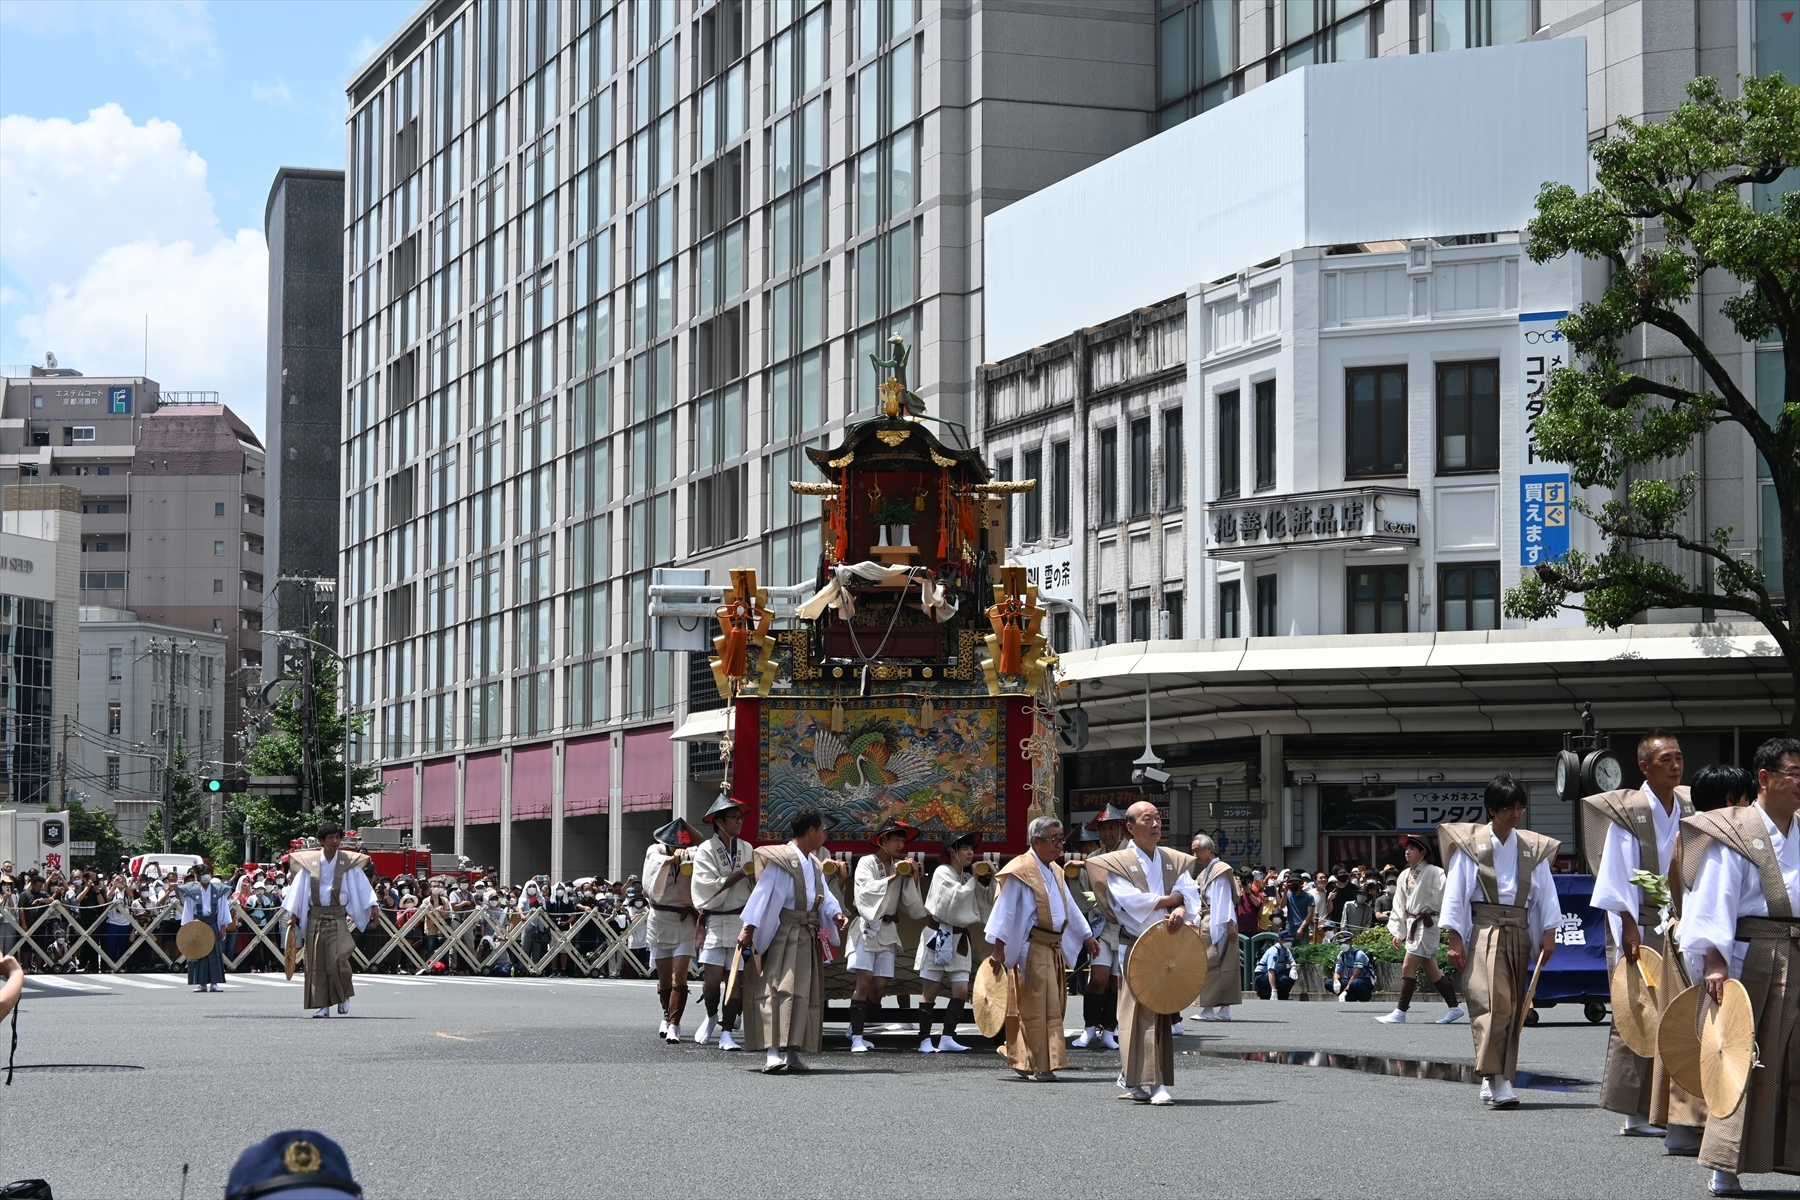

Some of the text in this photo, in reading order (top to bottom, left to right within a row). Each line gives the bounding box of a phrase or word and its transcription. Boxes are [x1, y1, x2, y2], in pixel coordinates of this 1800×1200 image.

[55, 389, 104, 397] エステムコート
[62, 398, 98, 406] 京都河原町
[1526, 356, 1546, 465] コンタト
[1214, 500, 1365, 544] 池善化粧品店
[1546, 483, 1563, 525] すぐ
[1524, 483, 1544, 563] 買えます
[9, 557, 34, 574] SEED
[1044, 560, 1071, 590] 雲の茶
